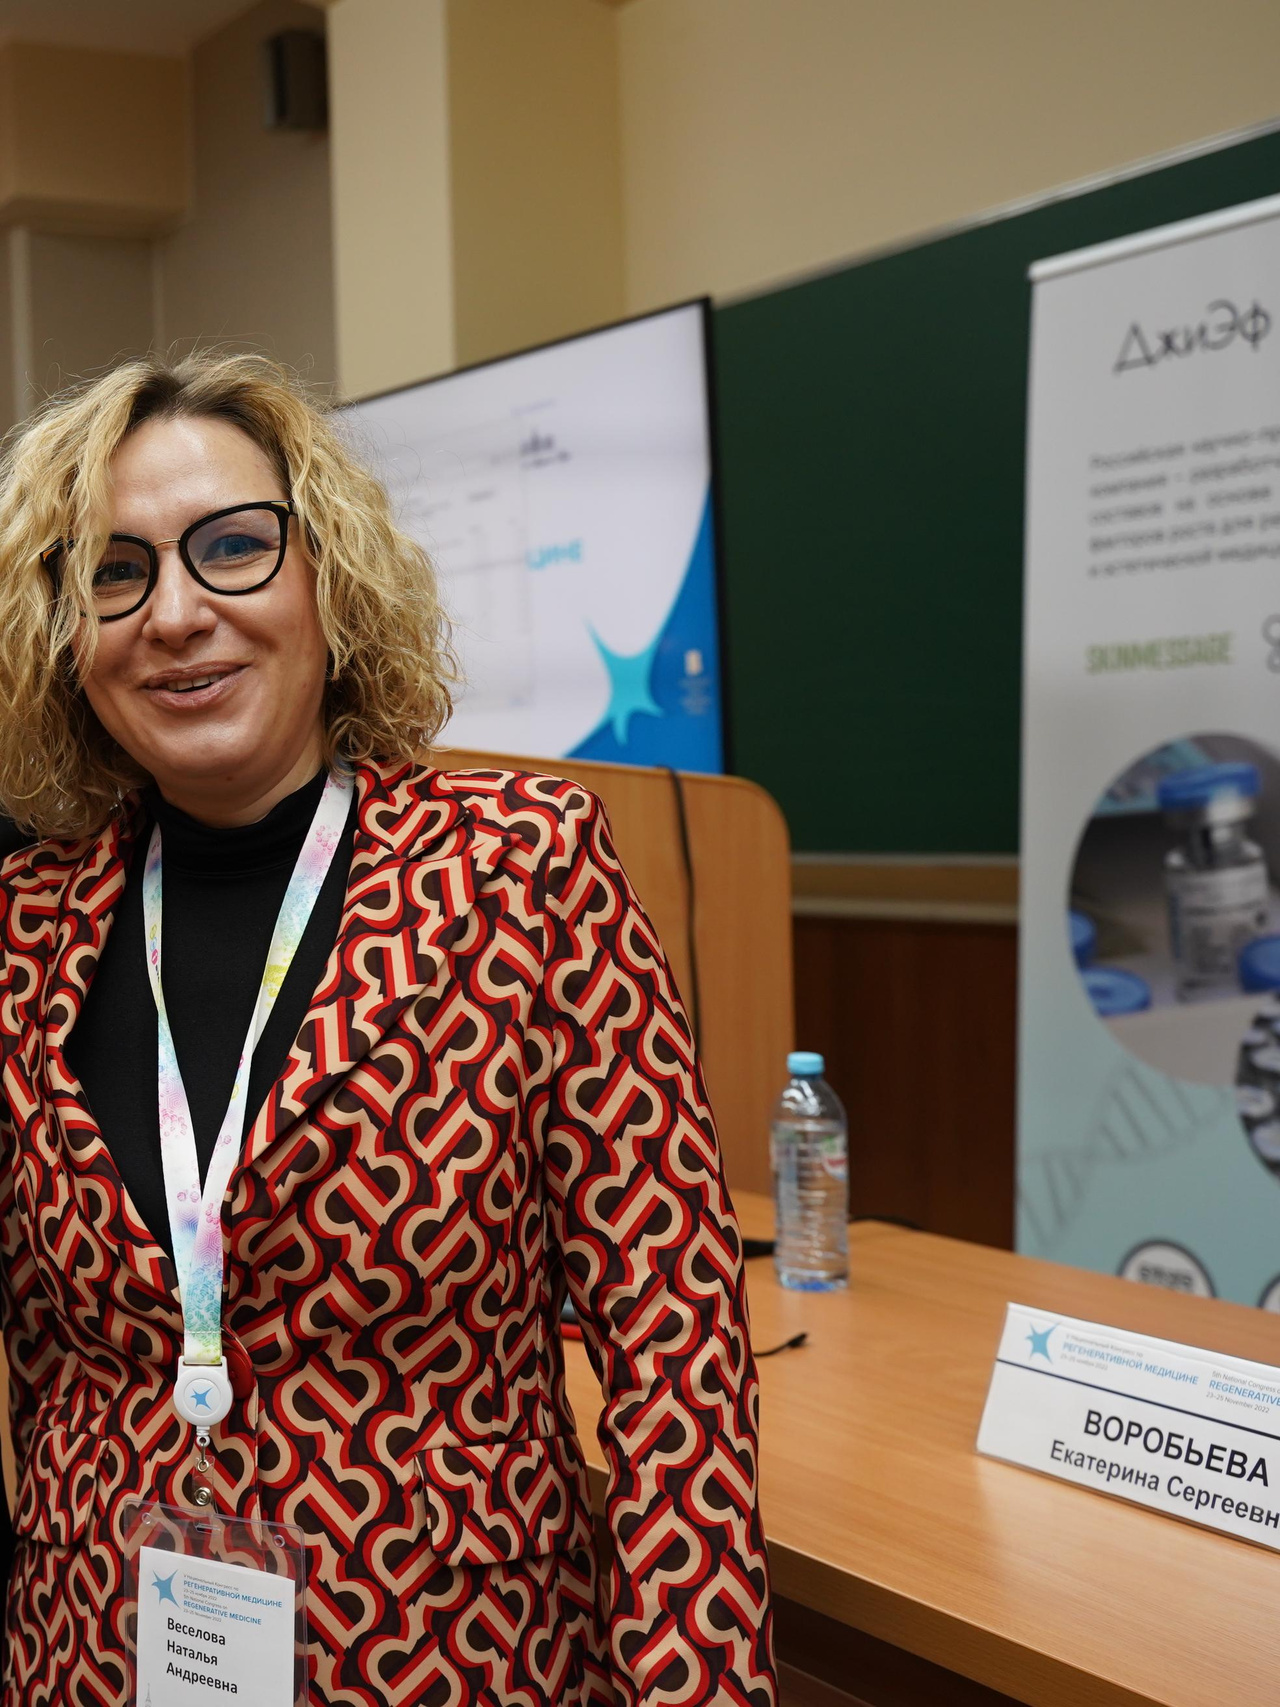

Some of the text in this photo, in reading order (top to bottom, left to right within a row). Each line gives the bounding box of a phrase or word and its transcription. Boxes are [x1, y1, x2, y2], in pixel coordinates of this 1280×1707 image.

[1113, 298, 1271, 375] ДжиЭф
[1062, 1342, 1199, 1385] РЕГЕНЕРАТИВНОЙ МЕДИЦИНЕ
[1254, 1403, 1270, 1414] 2022
[1083, 1409, 1269, 1487] ВОРОБЬЕВА
[1050, 1439, 1280, 1529] Екатерина Сергеевн
[183, 1580, 282, 1608] РЕГЕНЕРАТИВНОЙ МЕДИЦИНЕ
[183, 1600, 262, 1625] REGENERATIVE MEDICINE
[167, 1617, 226, 1645] Веселова
[167, 1639, 218, 1666] Наталья
[166, 1662, 238, 1694] Андреевна
